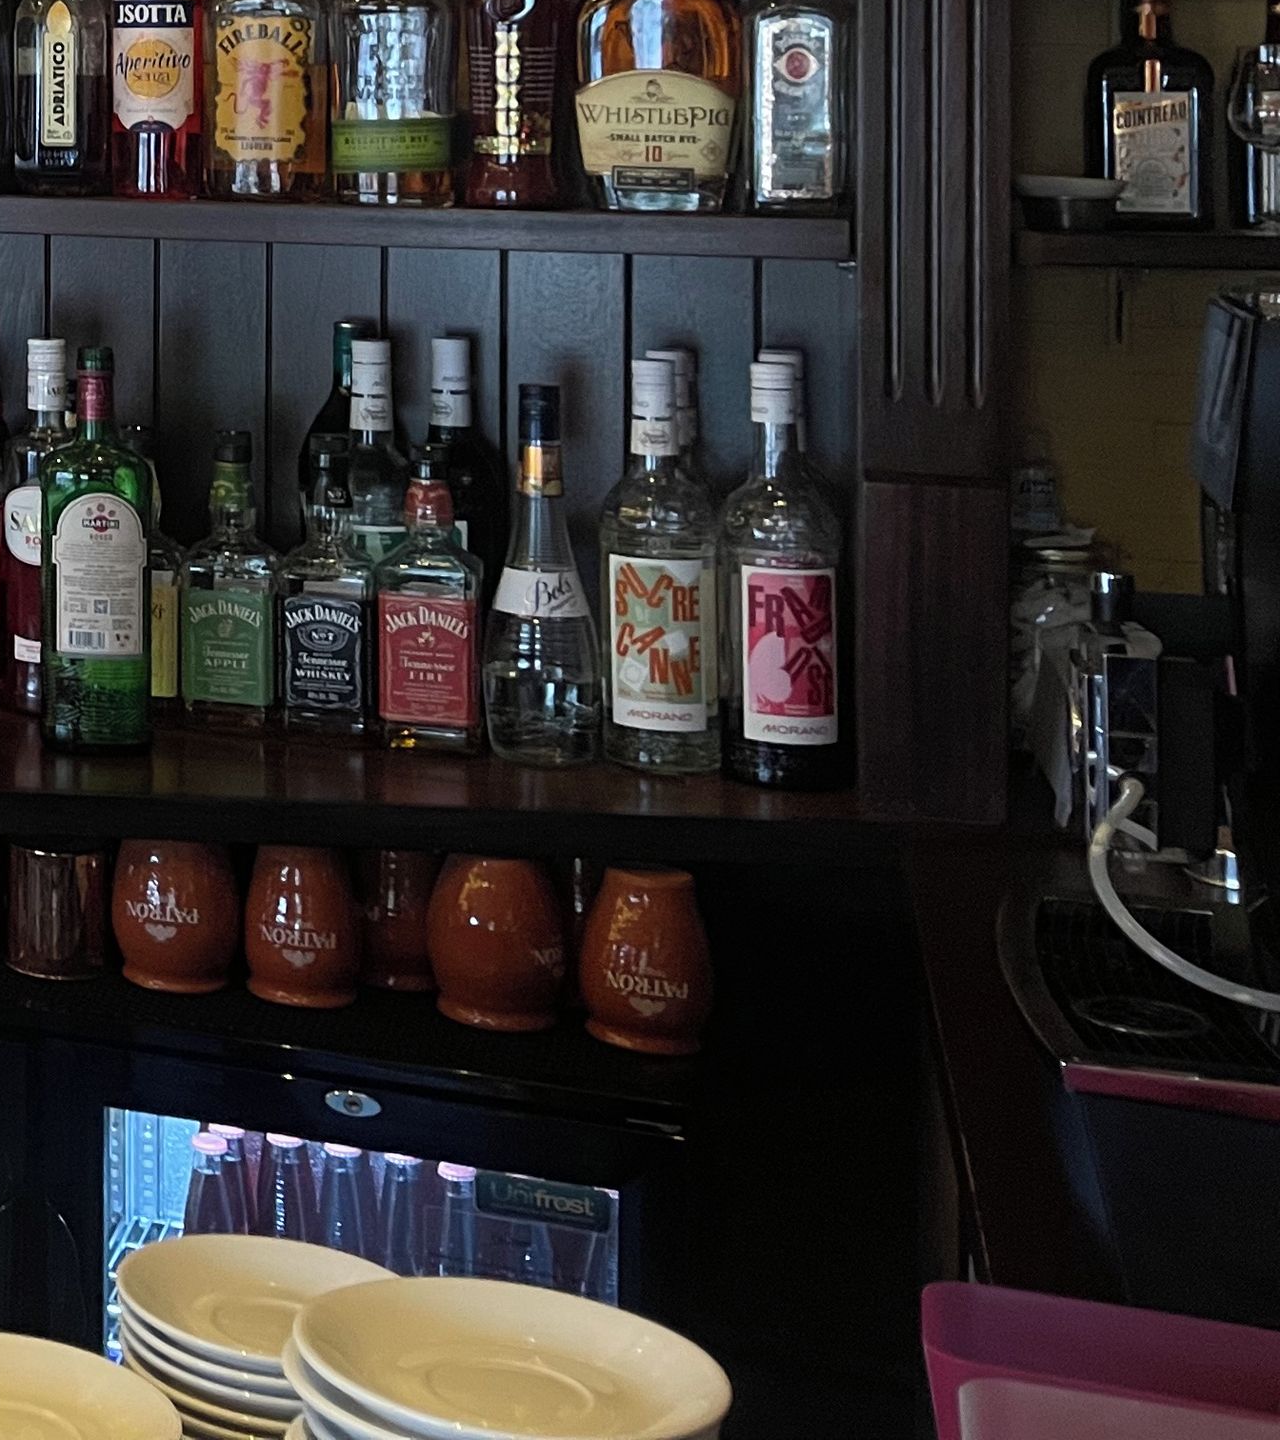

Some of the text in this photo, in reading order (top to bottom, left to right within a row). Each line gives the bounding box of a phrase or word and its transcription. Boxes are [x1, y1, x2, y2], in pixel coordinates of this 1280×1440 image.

[218, 23, 307, 58] FIREBALL
[115, 49, 192, 80] Aperitivo
[53, 41, 66, 127] ADRIATICO
[1116, 100, 1187, 131] COINTREAU
[645, 145, 662, 162] 10
[532, 572, 572, 613] Bols
[615, 562, 700, 622] SUCRE
[189, 599, 264, 628] JACK DANIEL'S
[285, 604, 362, 634] JACK DANIEL'S
[385, 606, 470, 640] JACK DANIEL'S
[294, 667, 352, 681] WHISKEY
[615, 621, 700, 697] CANNE
